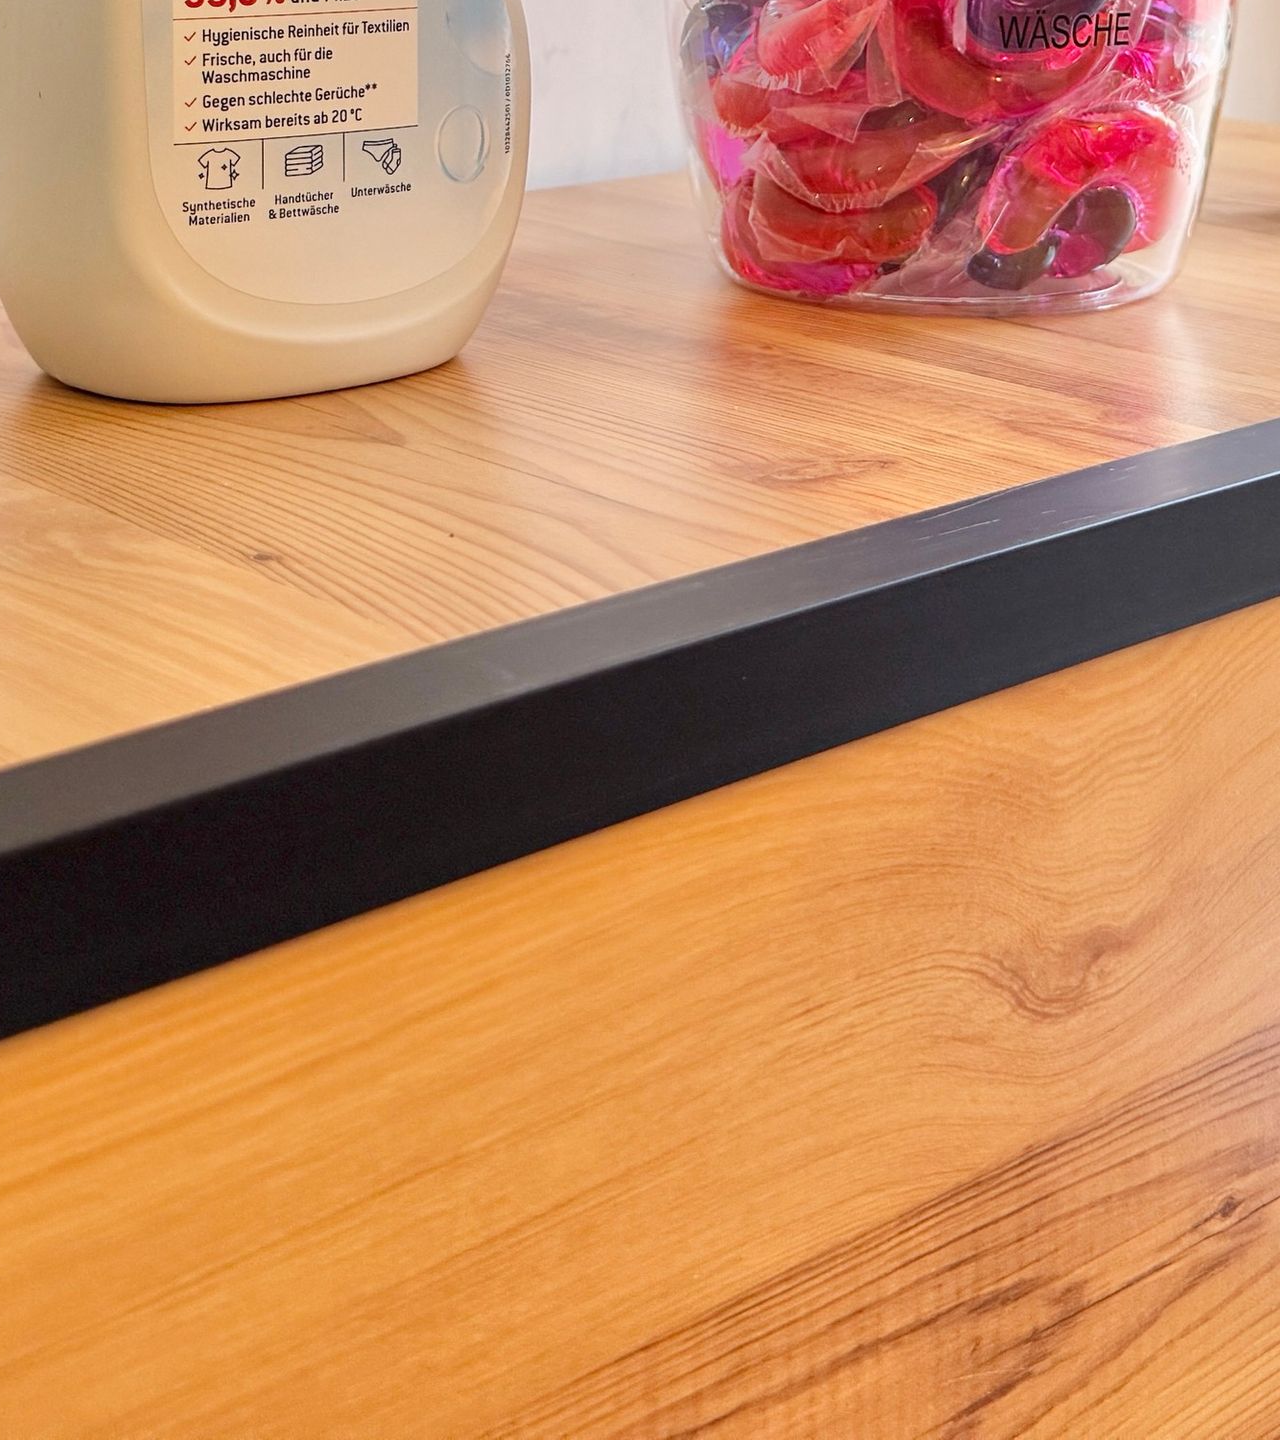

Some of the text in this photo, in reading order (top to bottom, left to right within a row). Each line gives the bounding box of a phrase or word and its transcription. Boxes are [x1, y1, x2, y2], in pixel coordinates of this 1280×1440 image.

[202, 19, 410, 46] Hygienische Reinheit für Textilien
[999, 10, 1131, 50] WÄSCHE
[202, 46, 333, 67] Frische, auch für die
[202, 66, 311, 85] Waschmaschine
[202, 93, 246, 111] Gegen
[248, 88, 312, 106] schlechte
[202, 116, 262, 133] Wirksam
[265, 113, 311, 129] bereits
[313, 110, 329, 125] ab
[331, 108, 348, 123] 20
[274, 191, 334, 206] Handtücher
[351, 181, 412, 198] Unterwäsche
[182, 197, 256, 215] Synthetische
[268, 204, 340, 220] & Bettwäsche
[188, 212, 251, 227] Materialien
